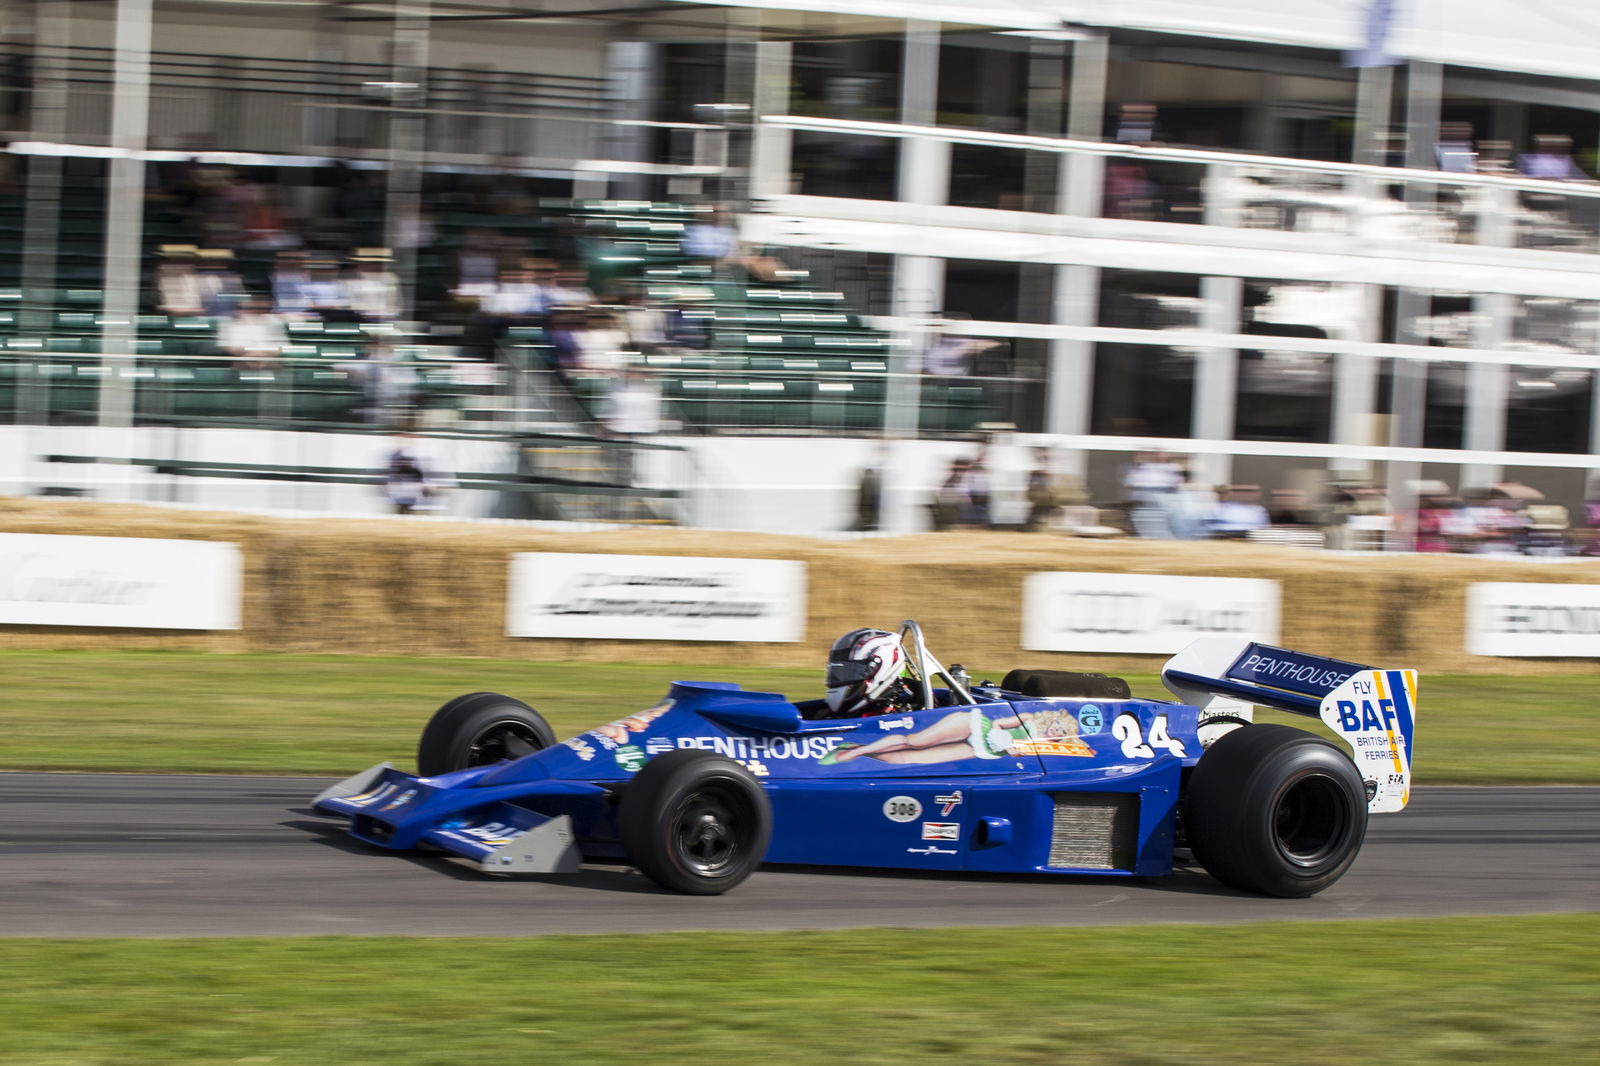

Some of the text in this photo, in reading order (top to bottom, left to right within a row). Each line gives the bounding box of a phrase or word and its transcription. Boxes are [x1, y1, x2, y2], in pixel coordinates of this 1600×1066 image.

[1241, 655, 1350, 689] PENTHOUSE
[1353, 681, 1371, 694] FLY
[1080, 715, 1102, 727] G
[1336, 699, 1396, 731] BAF
[1111, 712, 1188, 758] 24
[1356, 736, 1405, 747] BRITISH AIR
[676, 736, 844, 760] PENTHOUSE
[1365, 750, 1400, 760] FERRIES
[1388, 774, 1404, 784] FIA
[889, 802, 917, 817] 308
